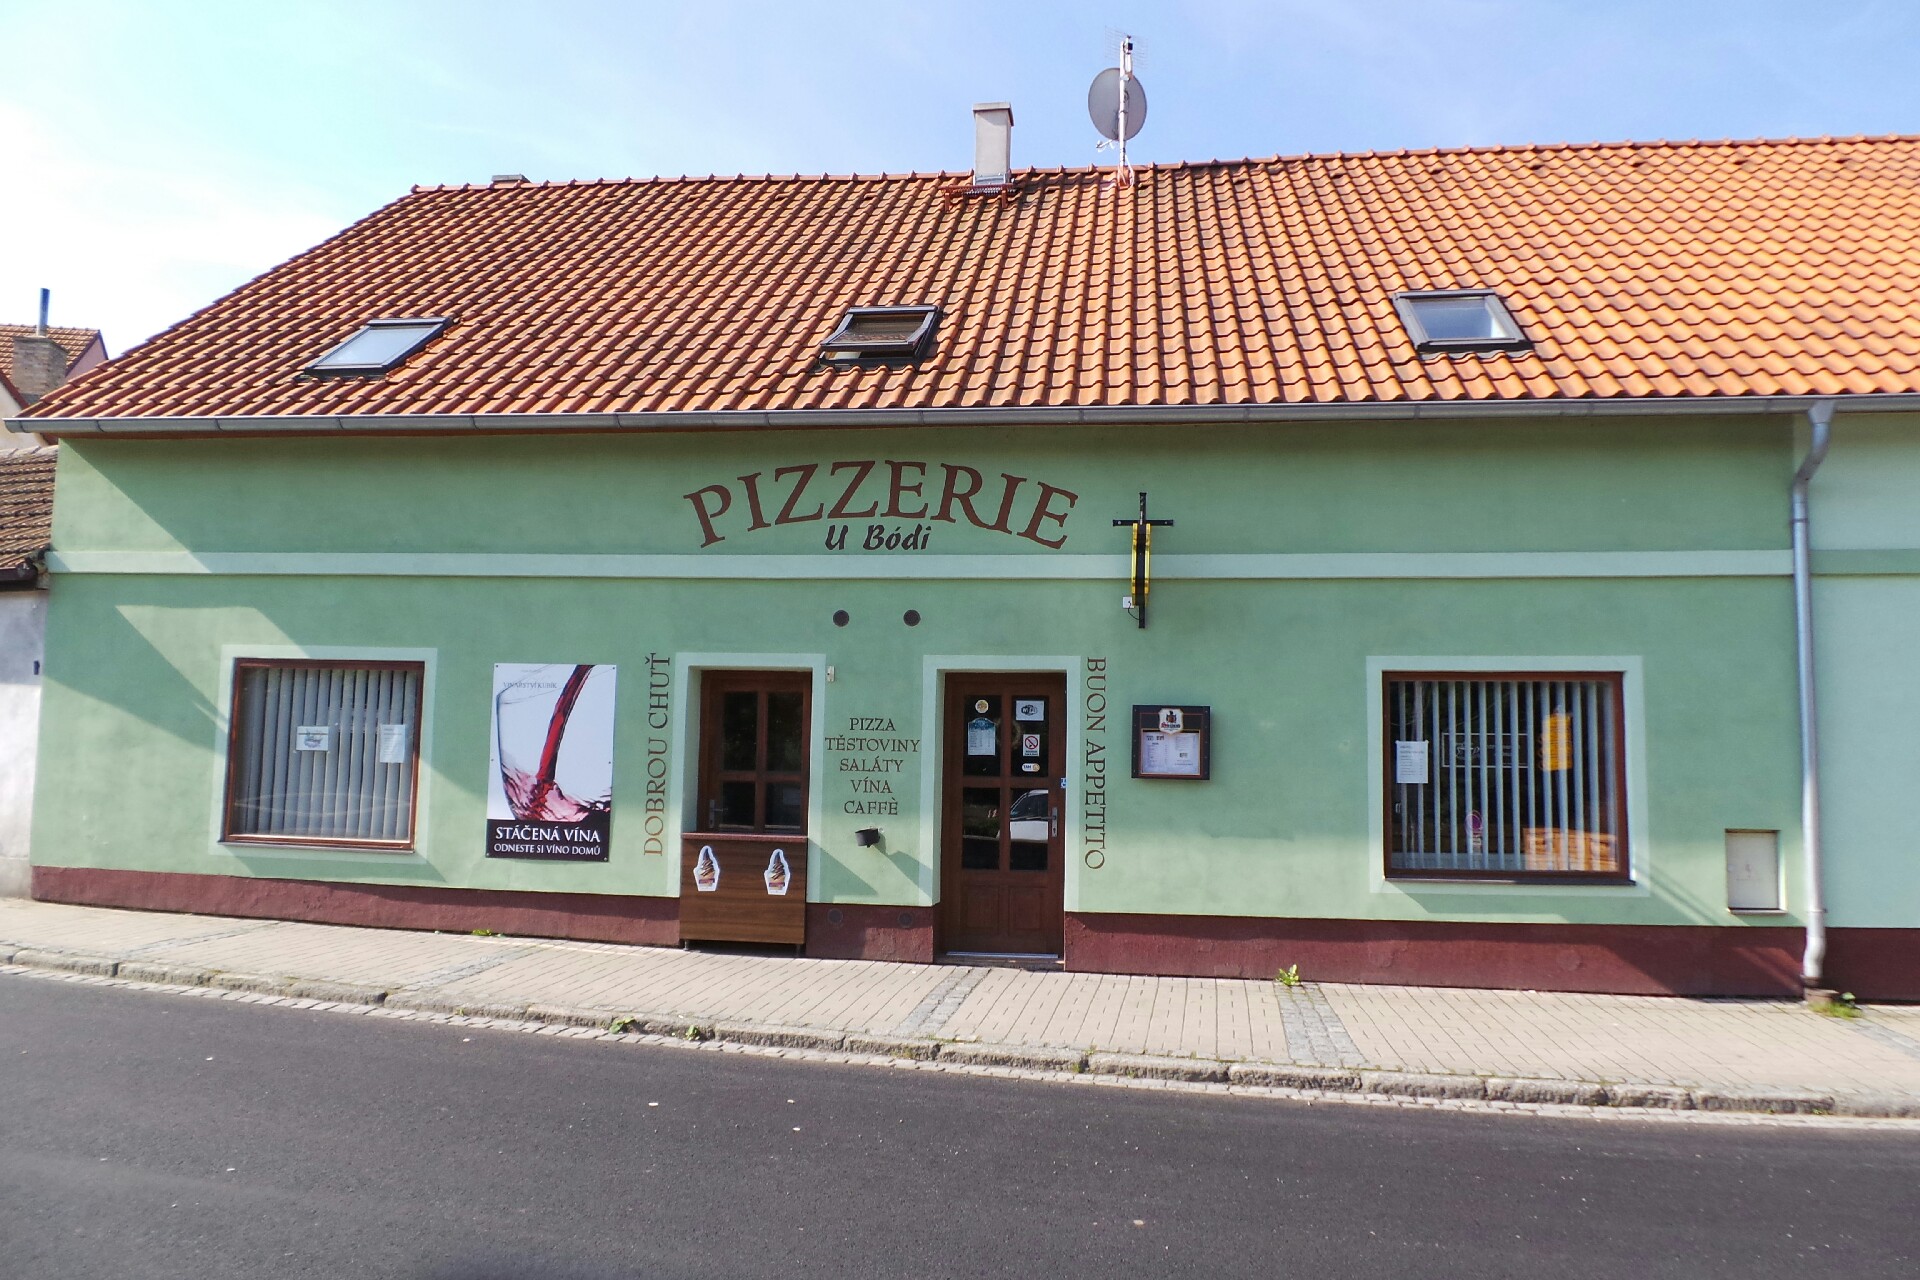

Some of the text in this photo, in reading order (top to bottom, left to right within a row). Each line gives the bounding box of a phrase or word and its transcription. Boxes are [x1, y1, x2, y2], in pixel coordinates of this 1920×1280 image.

[683, 459, 1079, 550] PIZZERIE
[824, 523, 931, 551] U Bódi
[849, 717, 896, 732] PIZZA
[824, 734, 921, 753] TĚSTOVINY
[643, 652, 670, 857] DOBROU CHUŤ
[839, 755, 904, 773] SALÁTY
[1084, 656, 1107, 870] BUON APPETITO
[850, 776, 893, 794] VÍNA
[844, 797, 899, 816] CAFFÈ
[495, 824, 601, 843] STÁČENÁ VÍNA
[493, 843, 601, 856] ODNESTE SI VÍNO DOMŮ
